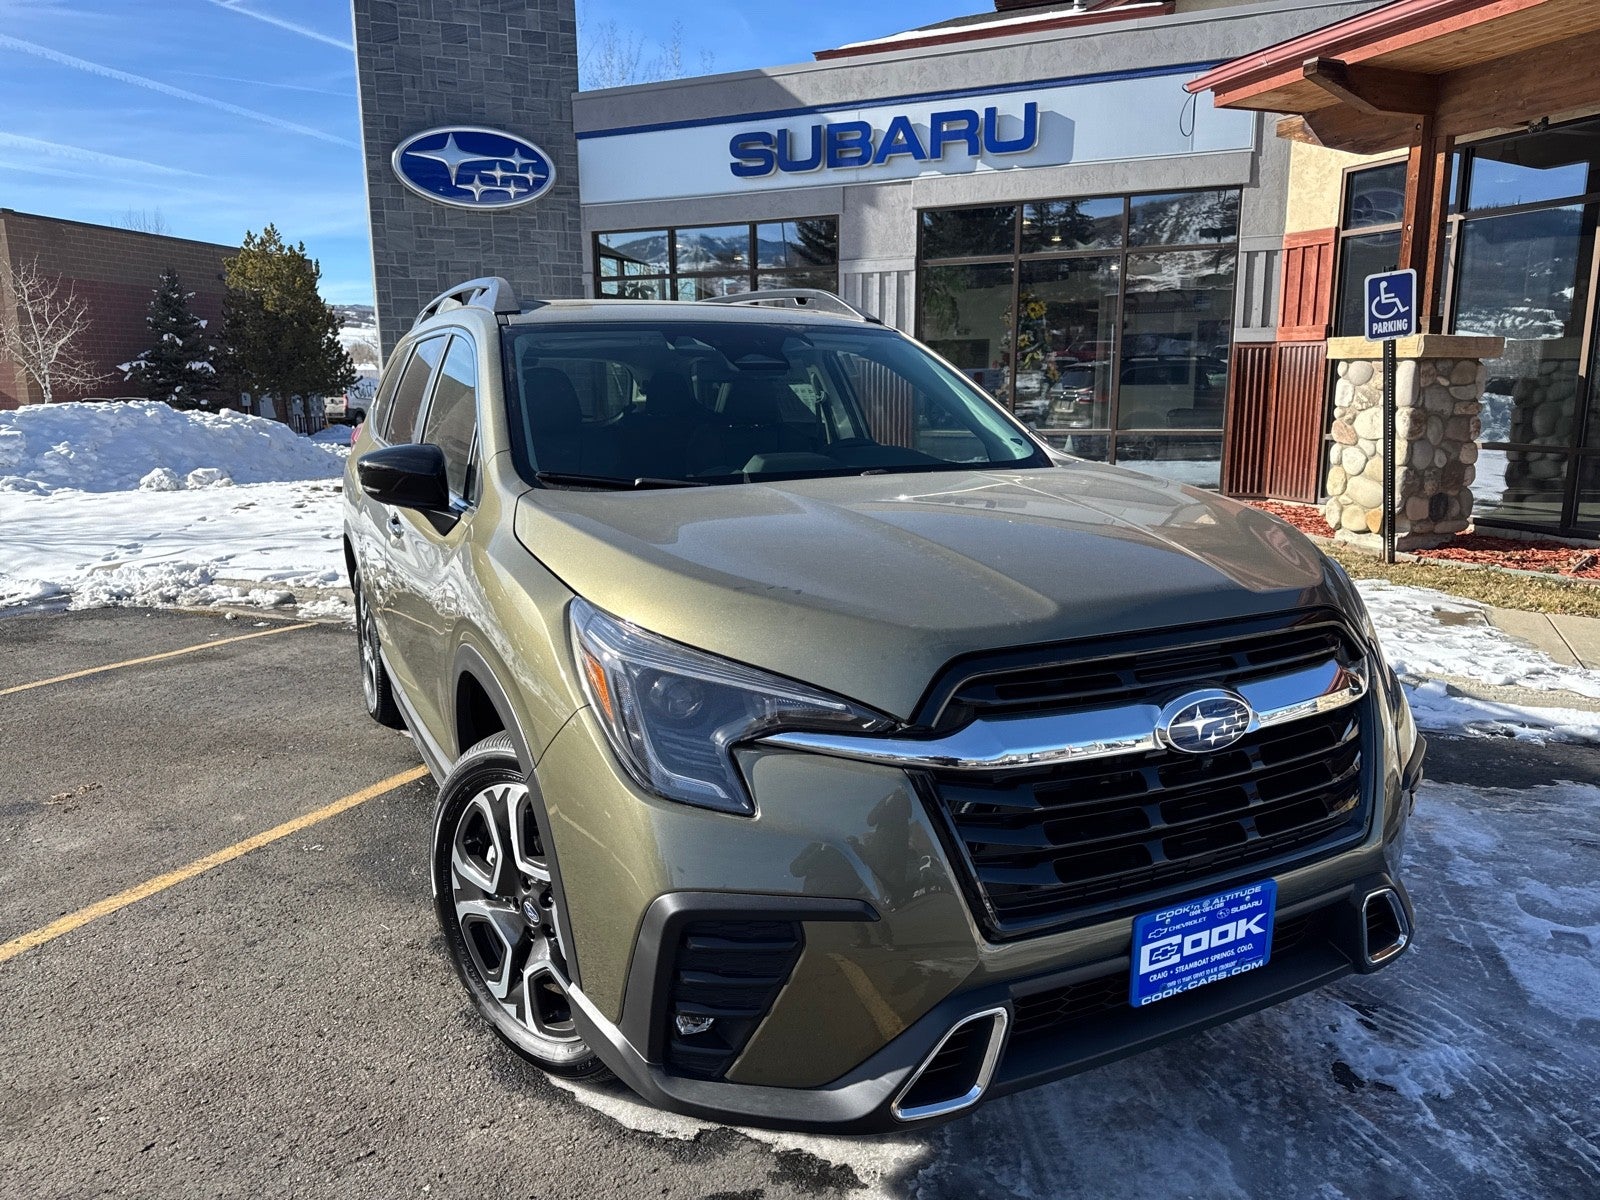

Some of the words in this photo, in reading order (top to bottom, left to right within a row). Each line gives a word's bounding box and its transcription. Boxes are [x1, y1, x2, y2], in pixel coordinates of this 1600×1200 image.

[729, 101, 1039, 179] SUBARU
[1372, 318, 1409, 335] PARKING
[1212, 885, 1262, 905] ALTITUDE
[1230, 899, 1263, 914] SUBARU
[1168, 916, 1208, 932] CHEVROLET
[1139, 912, 1267, 976] COOK
[1149, 970, 1169, 982] CRAIG
[1175, 957, 1209, 974] STEAMBOAT
[1141, 958, 1264, 1006] COOK-CARS.COM
